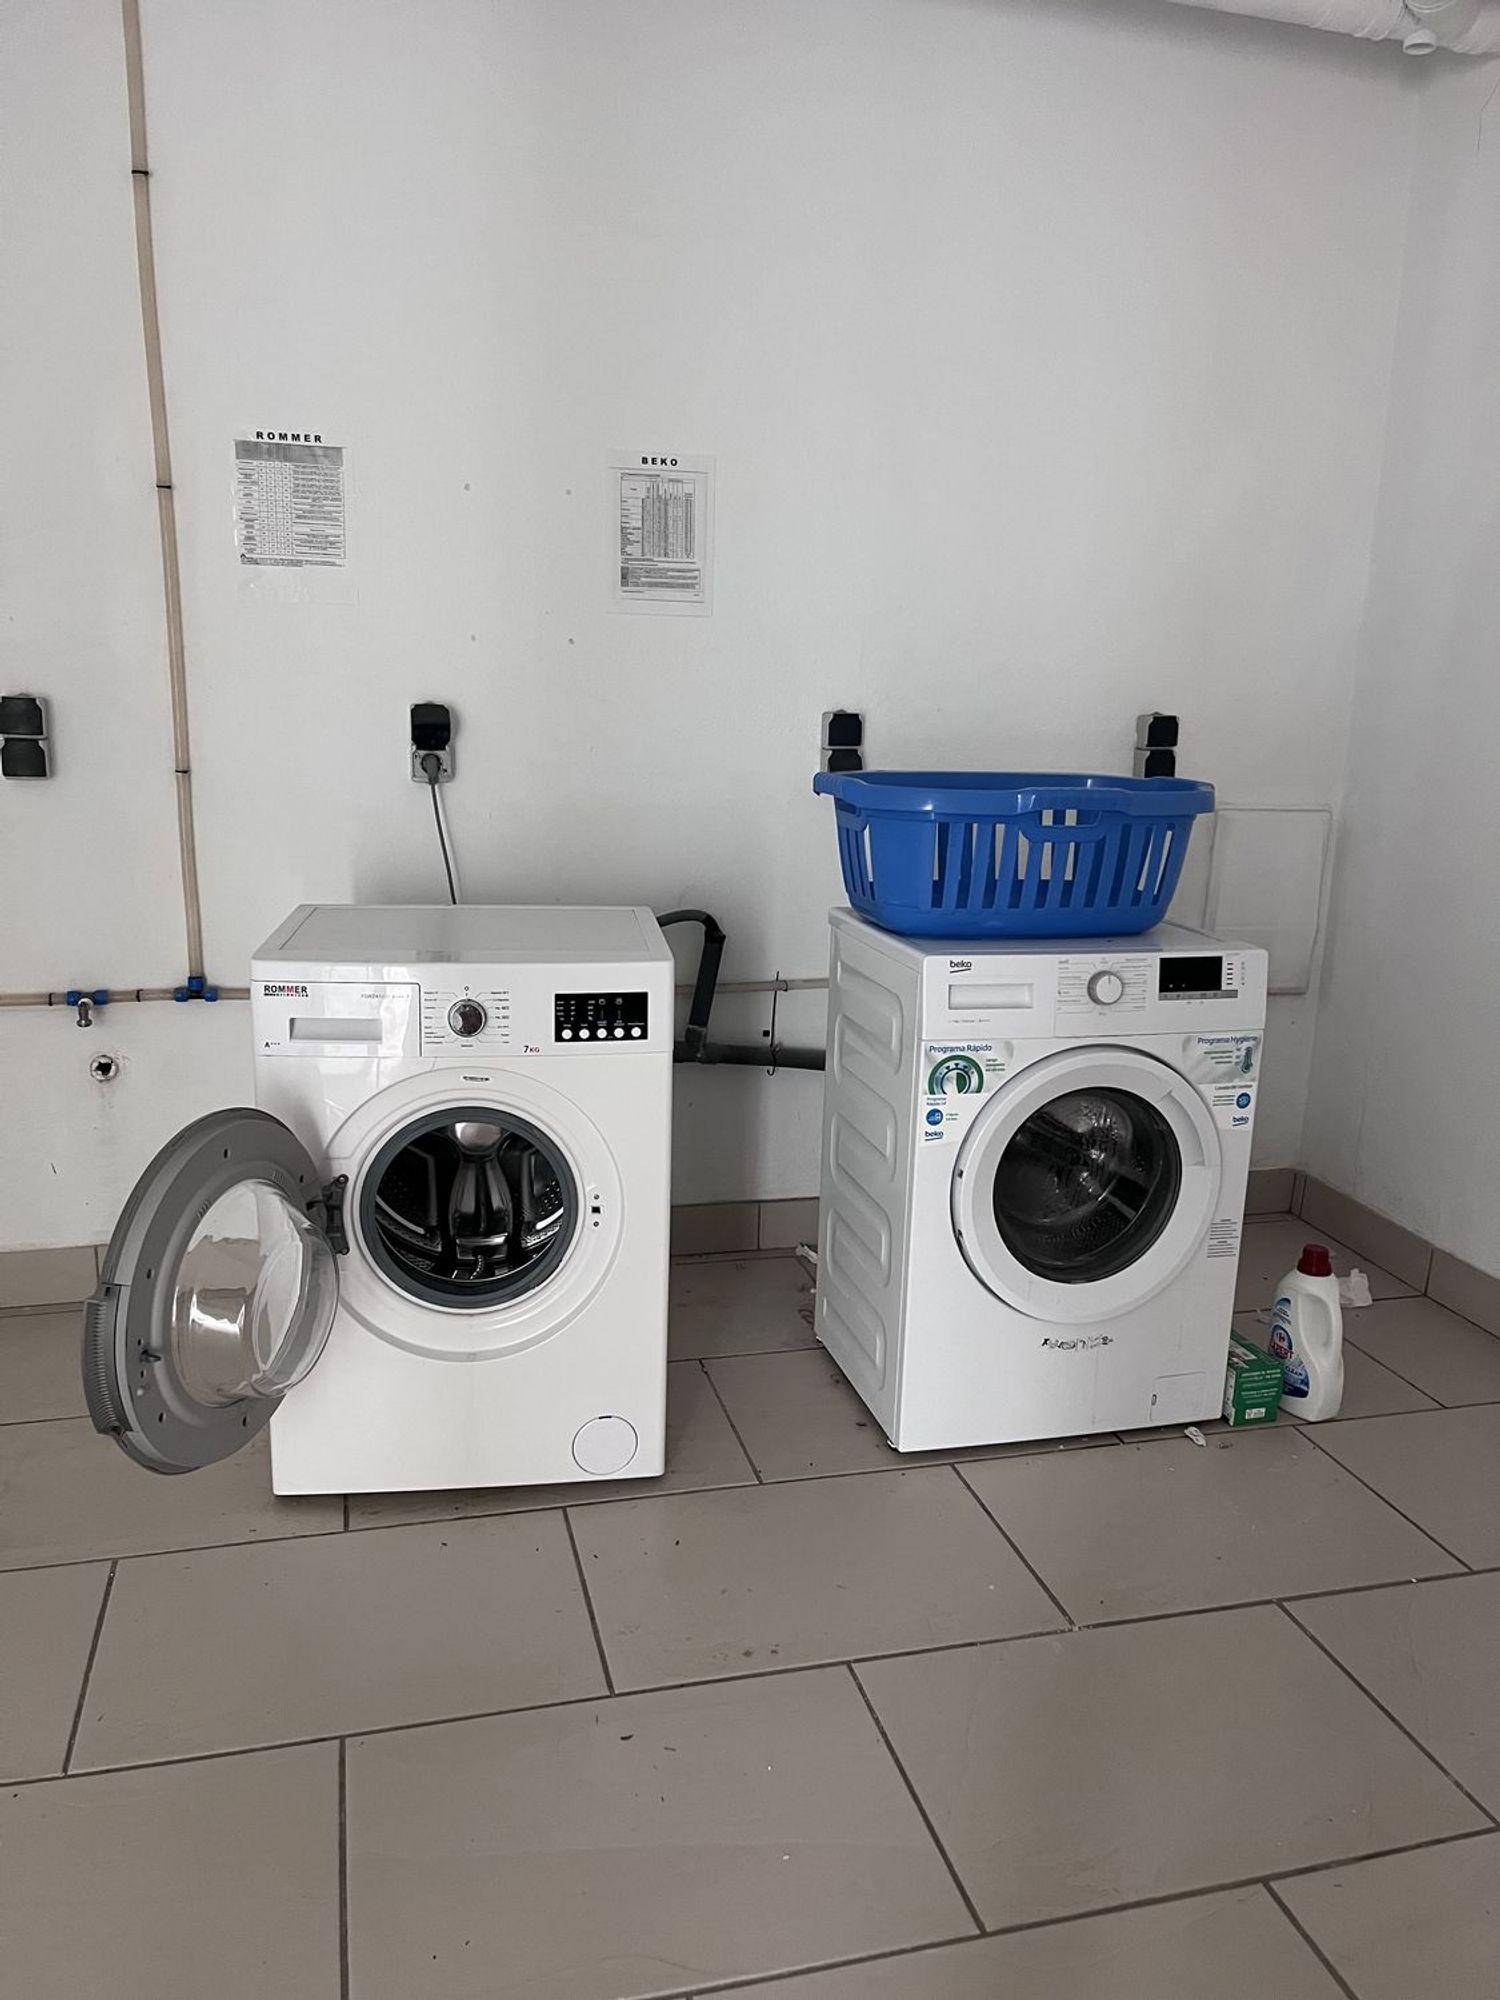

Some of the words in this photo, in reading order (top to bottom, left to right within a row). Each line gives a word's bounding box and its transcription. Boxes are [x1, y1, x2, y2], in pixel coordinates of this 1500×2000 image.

[256, 431, 322, 443] ROMMER
[641, 457, 678, 466] BEKO
[949, 960, 972, 969] beko
[264, 984, 308, 994] ROMMER
[1197, 1037, 1230, 1046] Programa
[929, 1045, 966, 1054] Programa
[1232, 1115, 1249, 1124] beko
[924, 1130, 944, 1139] beko
